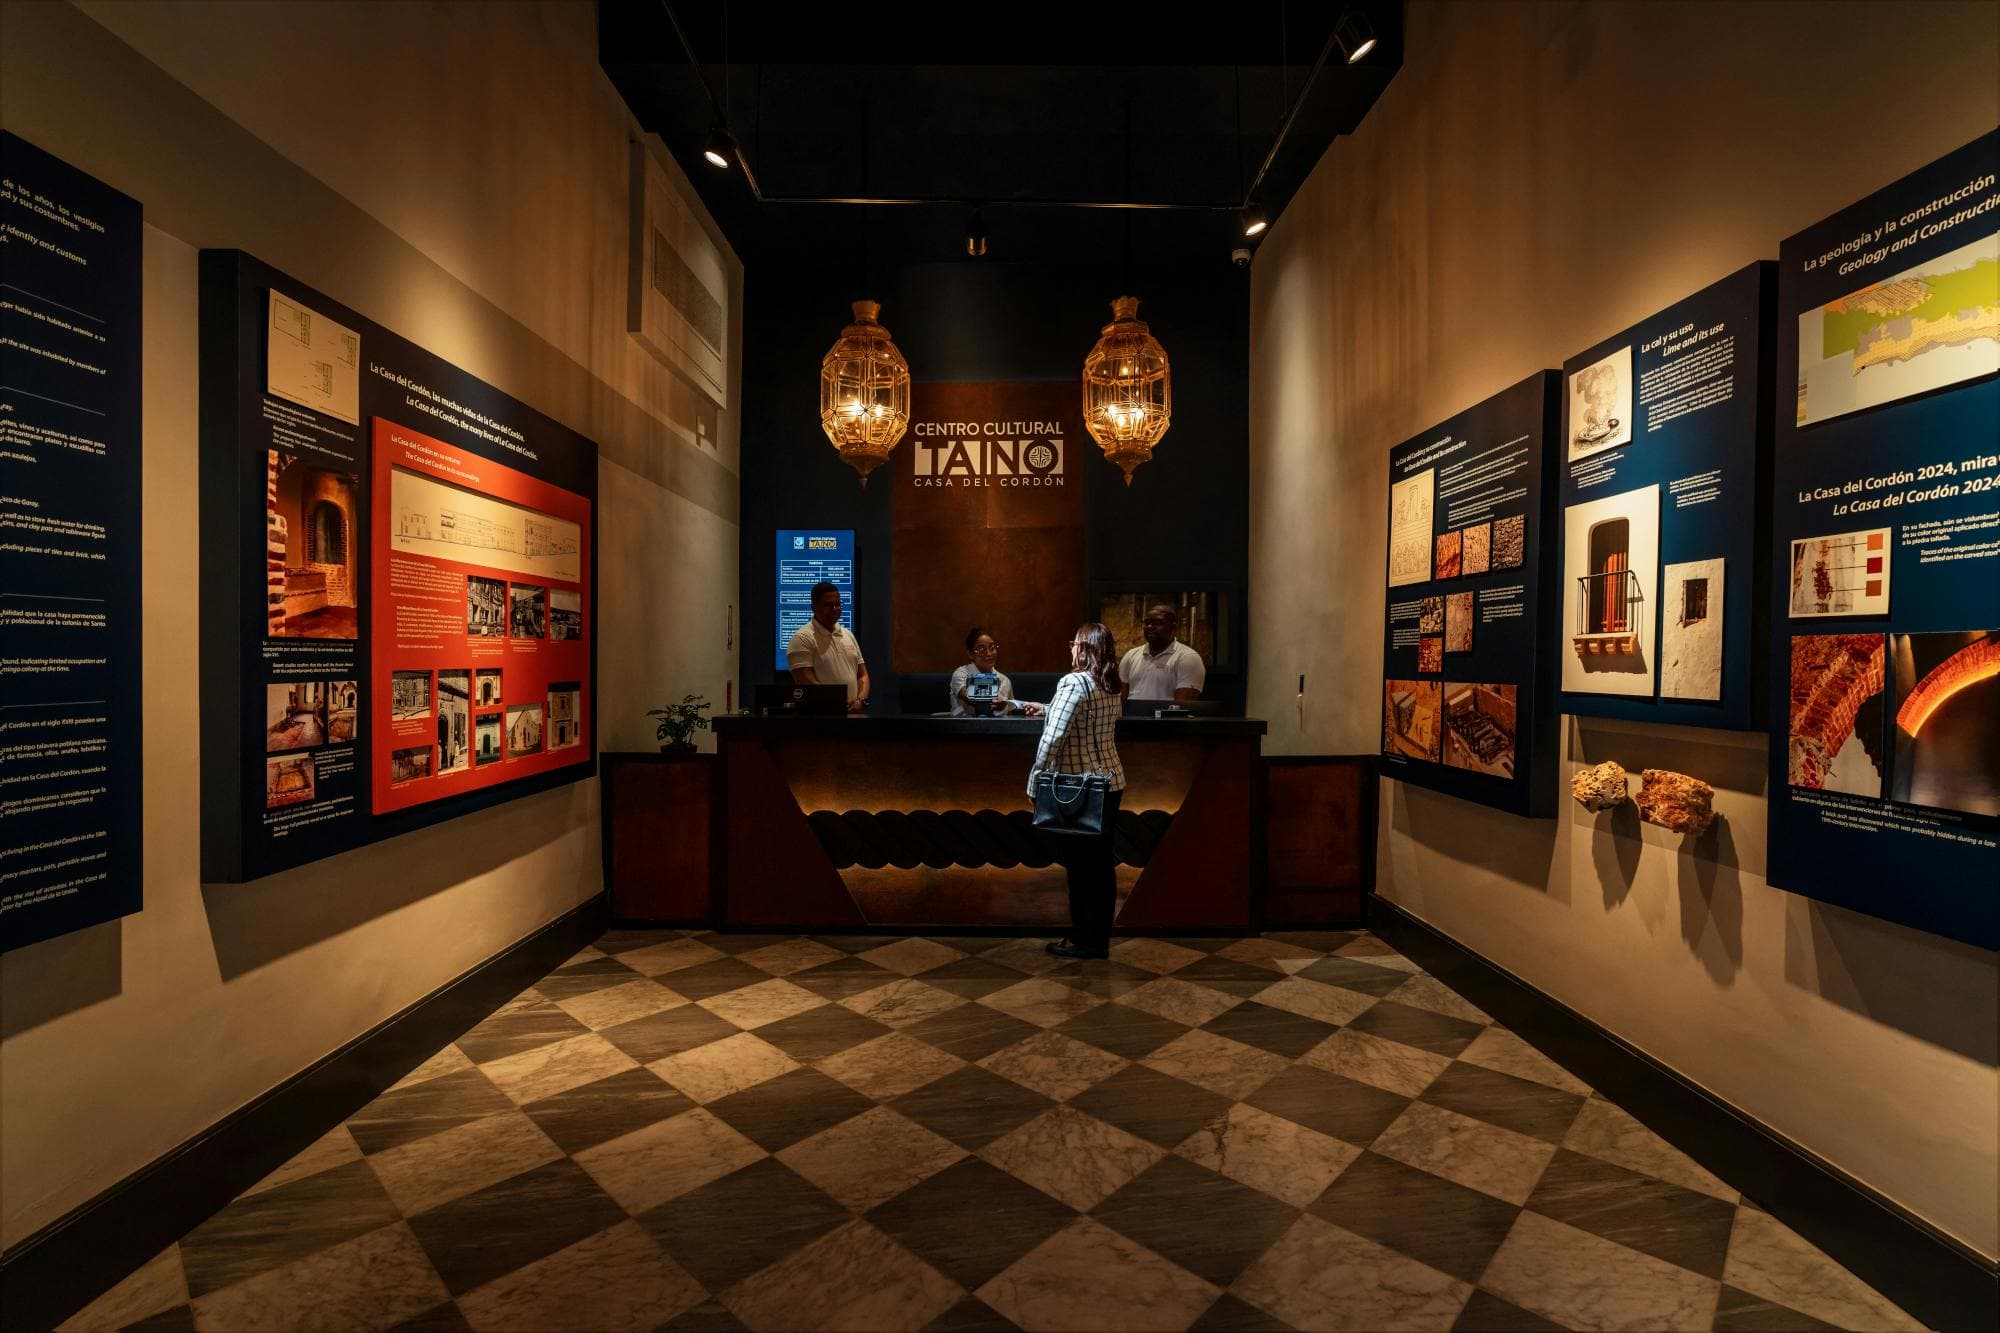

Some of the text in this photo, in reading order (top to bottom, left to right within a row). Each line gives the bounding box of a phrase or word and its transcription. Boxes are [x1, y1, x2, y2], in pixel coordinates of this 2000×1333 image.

[3, 179, 14, 190] de
[18, 185, 31, 198] los
[58, 204, 70, 217] los
[73, 213, 105, 233] vestigios
[12, 194, 80, 232] y sus costumbres.
[1804, 174, 1995, 272] La geología y la construcción
[6, 224, 39, 245] identity
[39, 240, 56, 252] and
[55, 248, 87, 266] customs
[1839, 246, 1890, 276] Geology
[1891, 229, 1919, 253] and
[8, 339, 19, 347] the
[1641, 323, 1694, 354] La cal y su uso
[1663, 323, 1725, 357] Lime and its use
[370, 362, 379, 374] La
[379, 367, 396, 382] Casa
[396, 375, 407, 387] del
[432, 391, 441, 403] las
[441, 398, 463, 413] muchas
[414, 399, 430, 413] Casa
[429, 406, 439, 417] del
[460, 420, 469, 430] the
[469, 425, 484, 438] many
[914, 421, 1064, 436] CENTRO CULTURAL
[914, 439, 1064, 475] TAINO
[914, 475, 1064, 487] CASA DEL CORDÓN
[1799, 455, 1998, 503] La Casa del Cordón 2024, mira
[1833, 504, 1848, 516] La
[1850, 499, 1881, 513] Casa
[1883, 492, 1904, 508] del
[1906, 484, 1960, 504] Cordón
[1957, 835, 1977, 845] during
